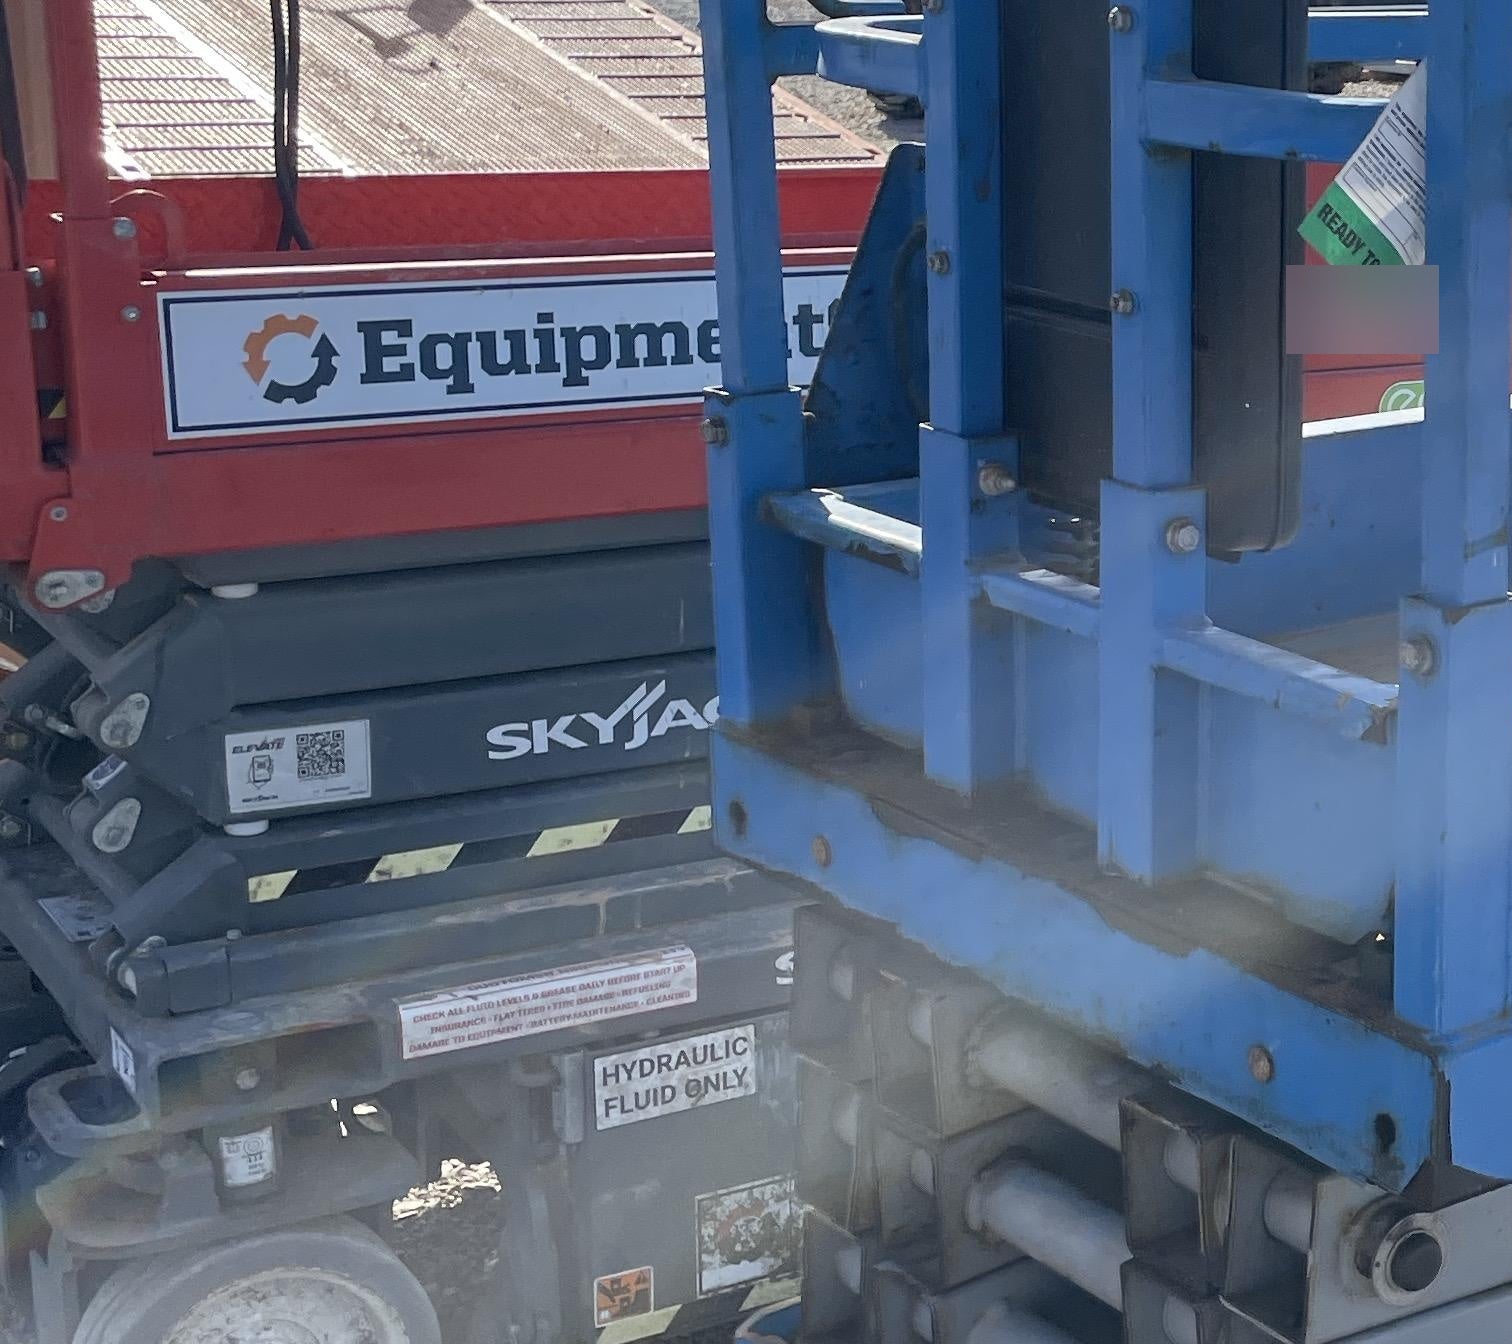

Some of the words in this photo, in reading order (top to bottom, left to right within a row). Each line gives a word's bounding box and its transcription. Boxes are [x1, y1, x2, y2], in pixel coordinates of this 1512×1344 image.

[1316, 202, 1367, 256] READY
[412, 1009, 446, 1024] CHECK
[578, 979, 606, 991] DAILY
[601, 1035, 749, 1087] HYDRAULIC
[603, 1084, 677, 1118] FLUID
[684, 1065, 748, 1099] ONLY
